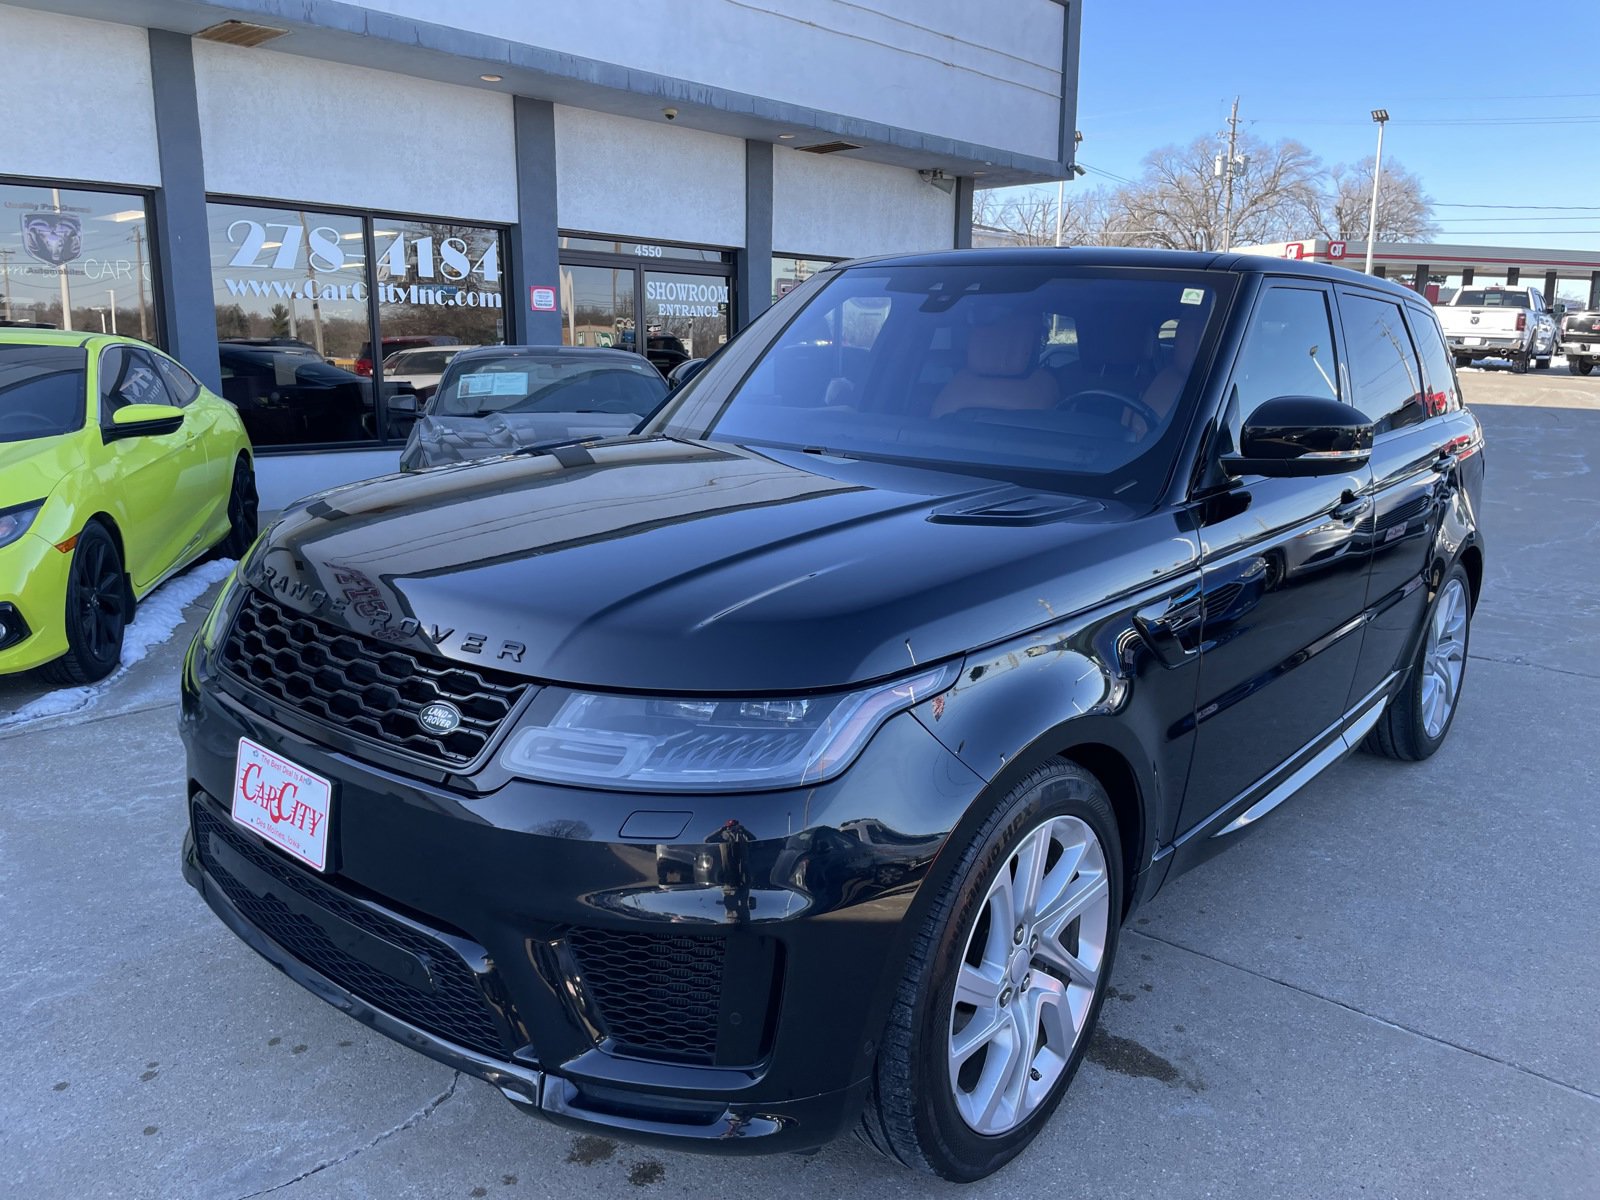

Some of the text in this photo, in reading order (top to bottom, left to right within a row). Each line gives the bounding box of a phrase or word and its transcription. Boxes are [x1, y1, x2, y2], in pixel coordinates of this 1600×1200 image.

[634, 245, 662, 257] 4550
[1330, 243, 1344, 257] QT
[84, 258, 132, 280] CAR
[646, 281, 729, 304] SHOWROOM
[658, 303, 719, 318] ENTRANCE
[261, 566, 526, 663] RANGE ROVER
[427, 707, 449, 719] LAND
[425, 715, 452, 729] ROVER
